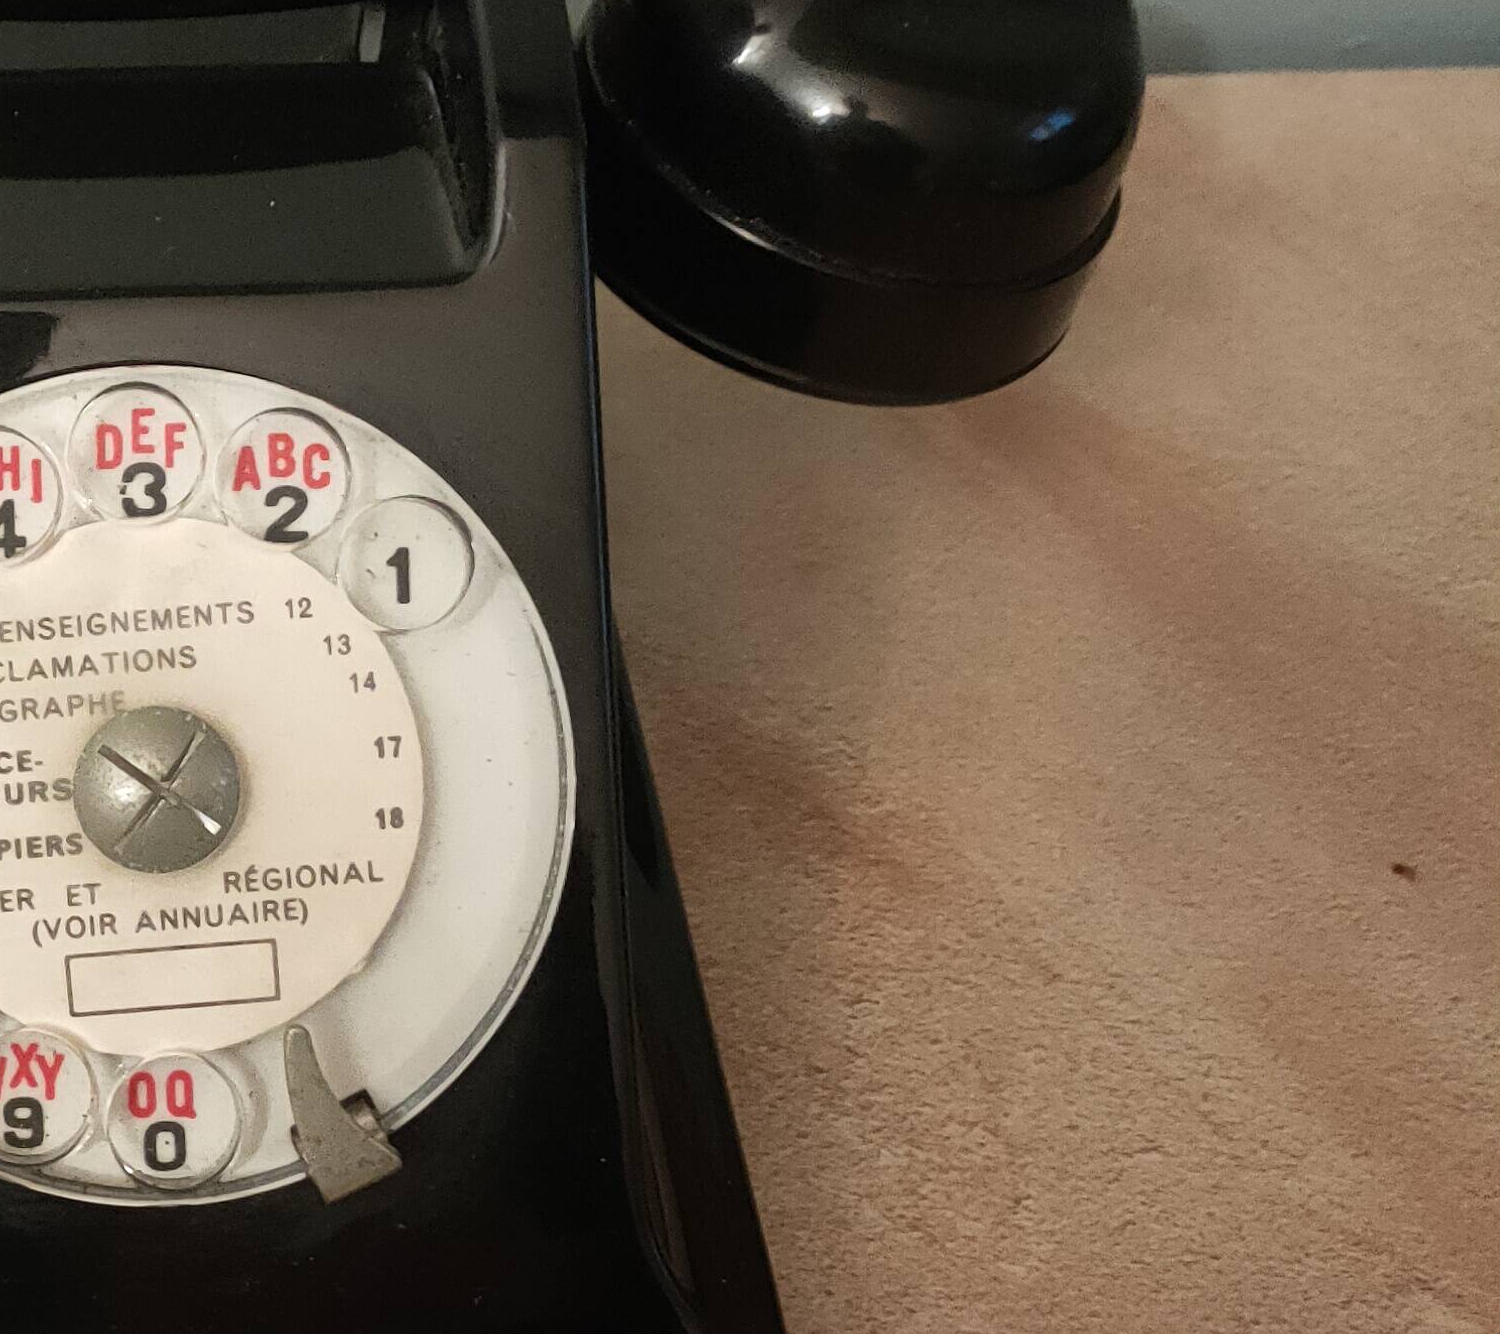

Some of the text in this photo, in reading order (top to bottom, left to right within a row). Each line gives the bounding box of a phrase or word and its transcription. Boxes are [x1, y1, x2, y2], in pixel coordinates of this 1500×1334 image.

[95, 407, 186, 469] DEF
[232, 433, 331, 491] ABC
[119, 462, 167, 518] 3
[263, 485, 308, 543] 2
[386, 546, 411, 604] 1
[285, 598, 313, 619] 12
[323, 634, 351, 656] 13
[349, 672, 376, 693] 14
[373, 735, 402, 759] 17
[375, 808, 404, 830] 18
[67, 883, 101, 907] ET
[223, 860, 384, 894] RÉGIONAL
[32, 898, 309, 947] (VOIR ANNUAIRE)
[127, 1070, 196, 1119] OQ
[3, 1096, 44, 1149] 9
[143, 1120, 186, 1172] 0
